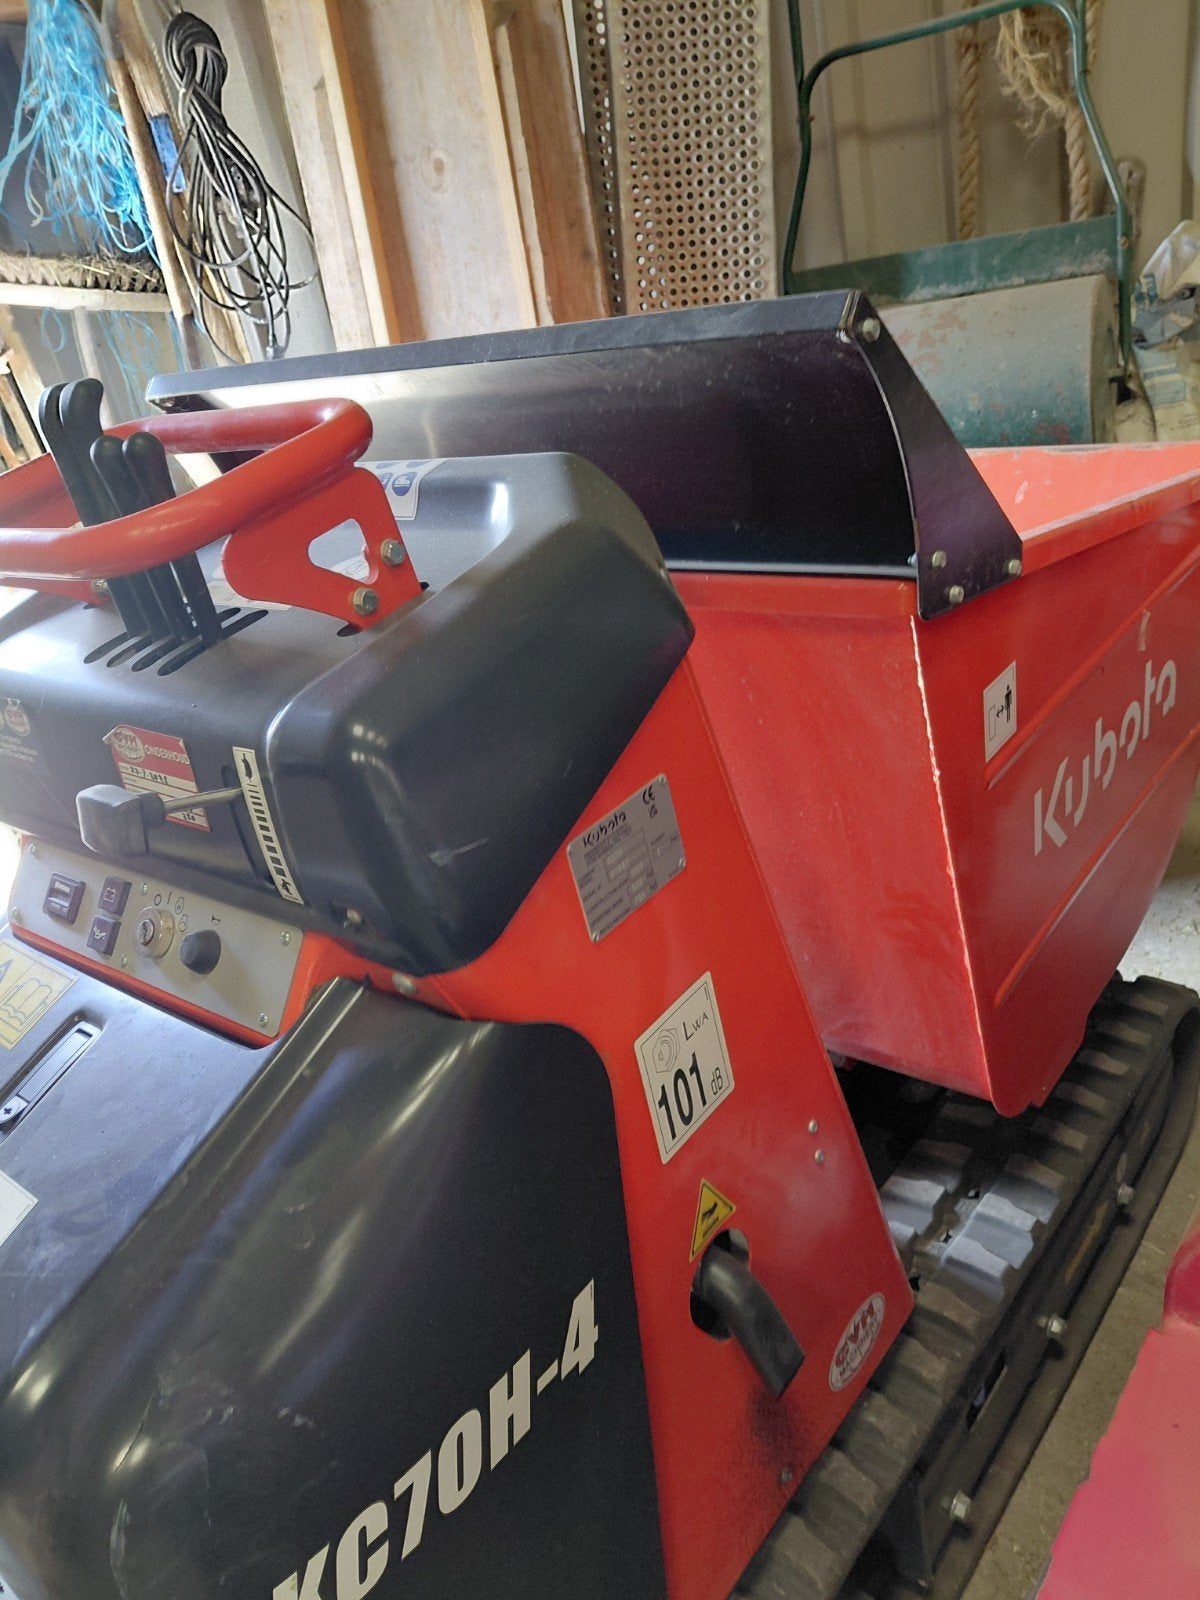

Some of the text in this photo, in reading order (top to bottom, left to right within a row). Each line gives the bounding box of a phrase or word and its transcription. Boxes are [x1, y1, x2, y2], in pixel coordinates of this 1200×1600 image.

[144, 744, 190, 764] ONDERHOUD
[1034, 660, 1177, 856] Kubota
[583, 810, 627, 848] Kubota
[658, 1051, 724, 1140] 101 dB
